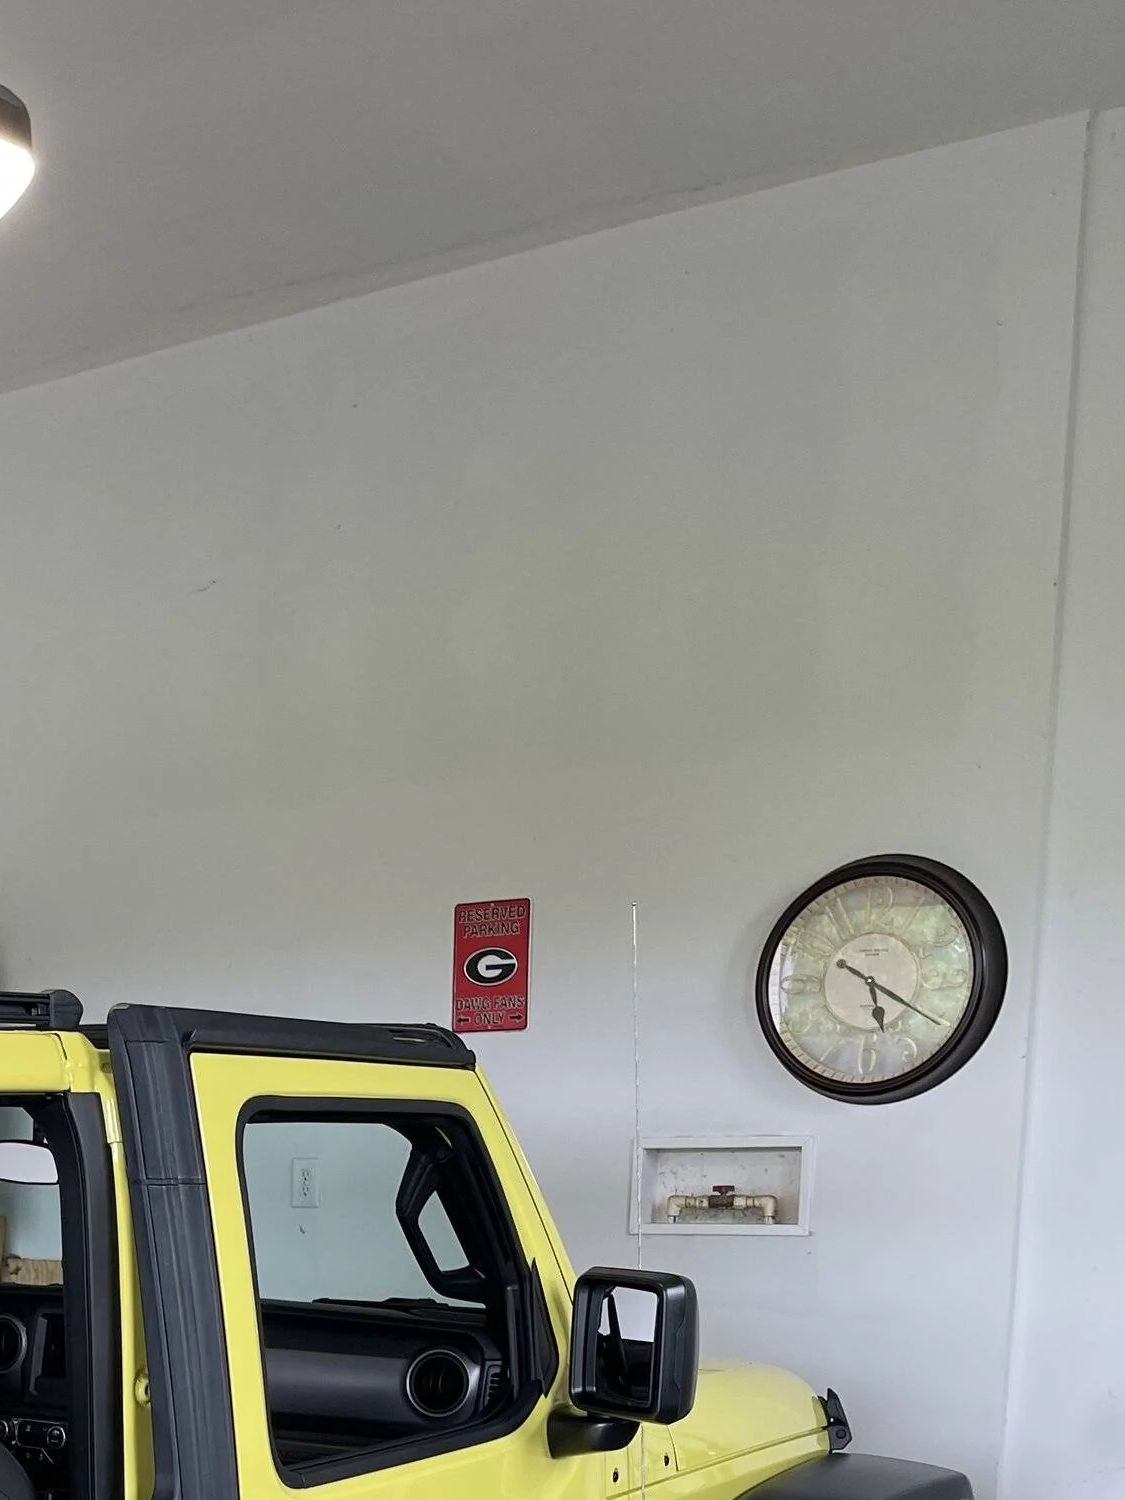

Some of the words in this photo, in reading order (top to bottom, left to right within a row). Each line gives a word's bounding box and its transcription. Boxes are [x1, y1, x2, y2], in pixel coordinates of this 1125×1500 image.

[459, 904, 525, 922] RESERVED
[464, 921, 521, 938] PARKING
[457, 997, 491, 1011] DAWG
[493, 995, 525, 1009] FANS
[475, 1012, 505, 1025] ONLY
